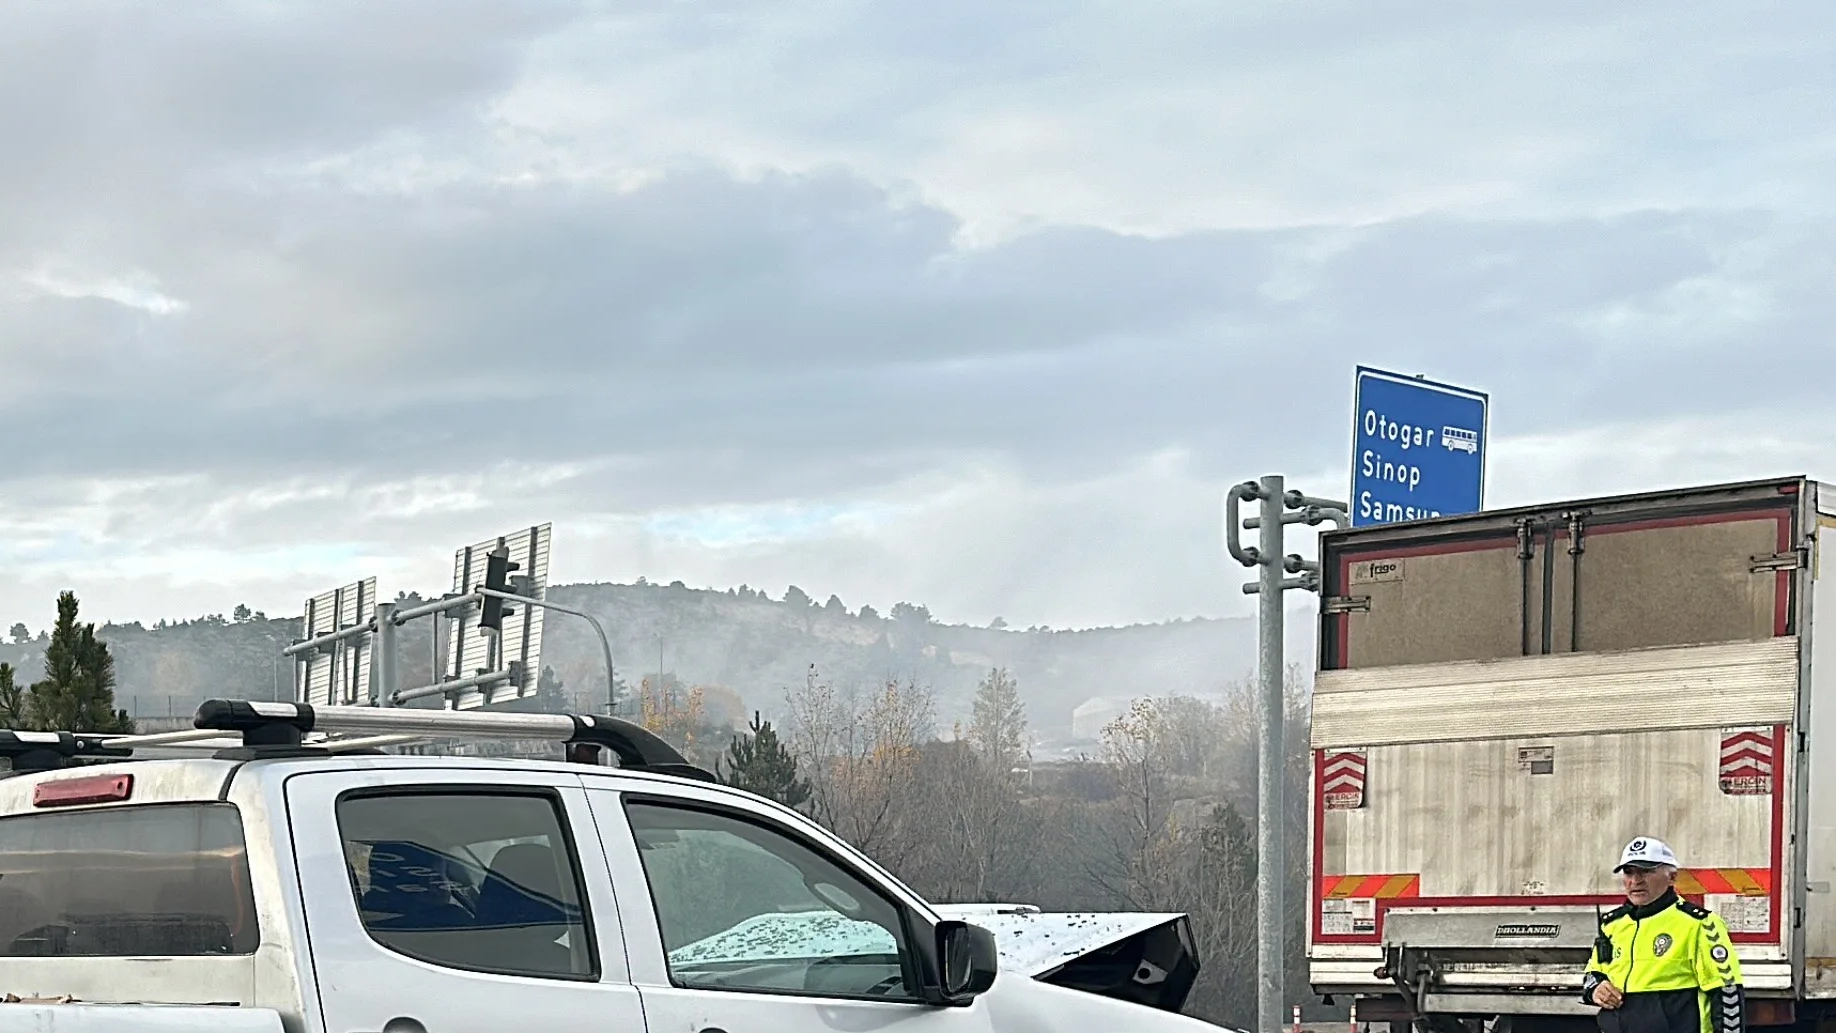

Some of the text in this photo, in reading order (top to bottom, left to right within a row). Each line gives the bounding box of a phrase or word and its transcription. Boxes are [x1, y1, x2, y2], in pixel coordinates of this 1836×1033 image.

[1365, 410, 1435, 449] Otogar
[1363, 450, 1420, 491] Sinop
[1497, 926, 1558, 934] DHOLLANDIA
